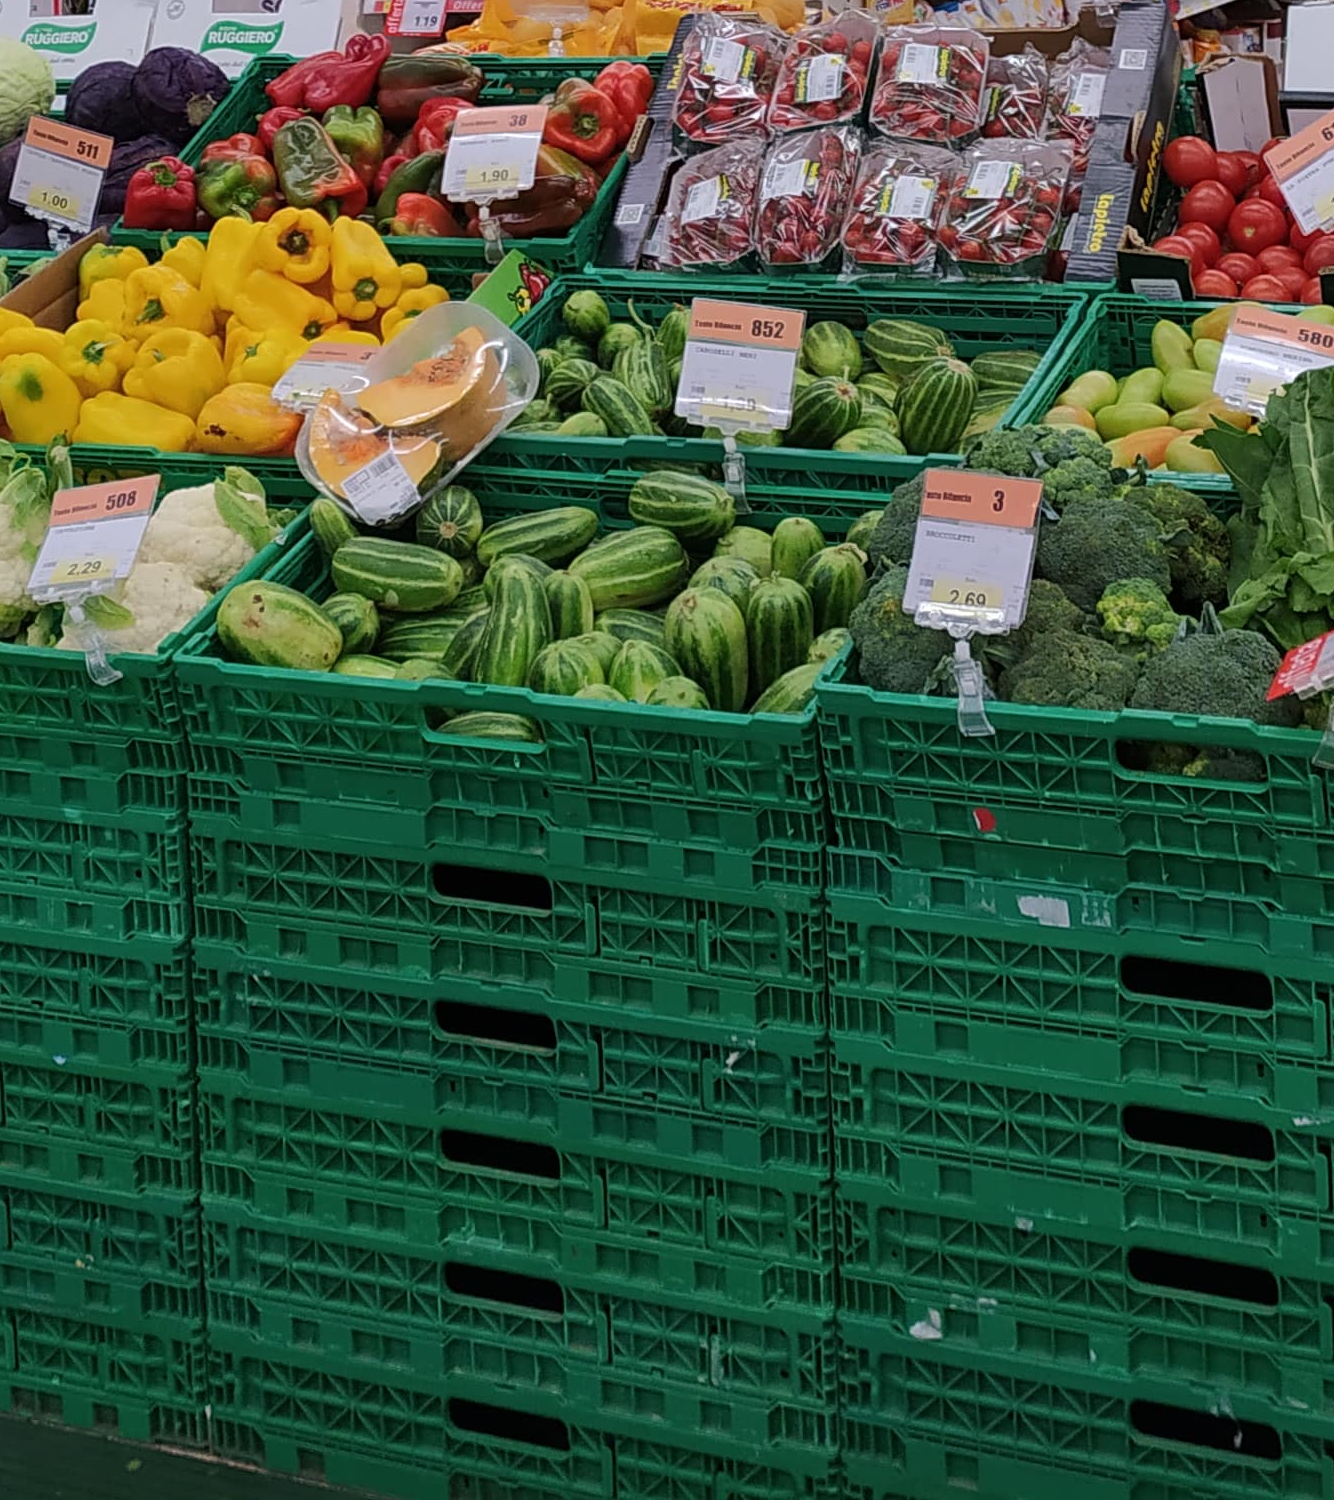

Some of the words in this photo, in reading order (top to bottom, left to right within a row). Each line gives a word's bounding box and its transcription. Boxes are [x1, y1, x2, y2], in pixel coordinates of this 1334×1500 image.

[453, 0, 484, 11] Offer
[25, 30, 89, 46] RUGGIERO
[208, 30, 276, 44] RUGGIERO
[509, 114, 528, 127] 38
[76, 140, 99, 160] 511
[751, 320, 785, 339] 852
[1298, 329, 1334, 348] 580
[105, 490, 137, 510] 508
[926, 491, 942, 500] asto
[992, 490, 1005, 512] 3
[950, 589, 986, 607] 269
